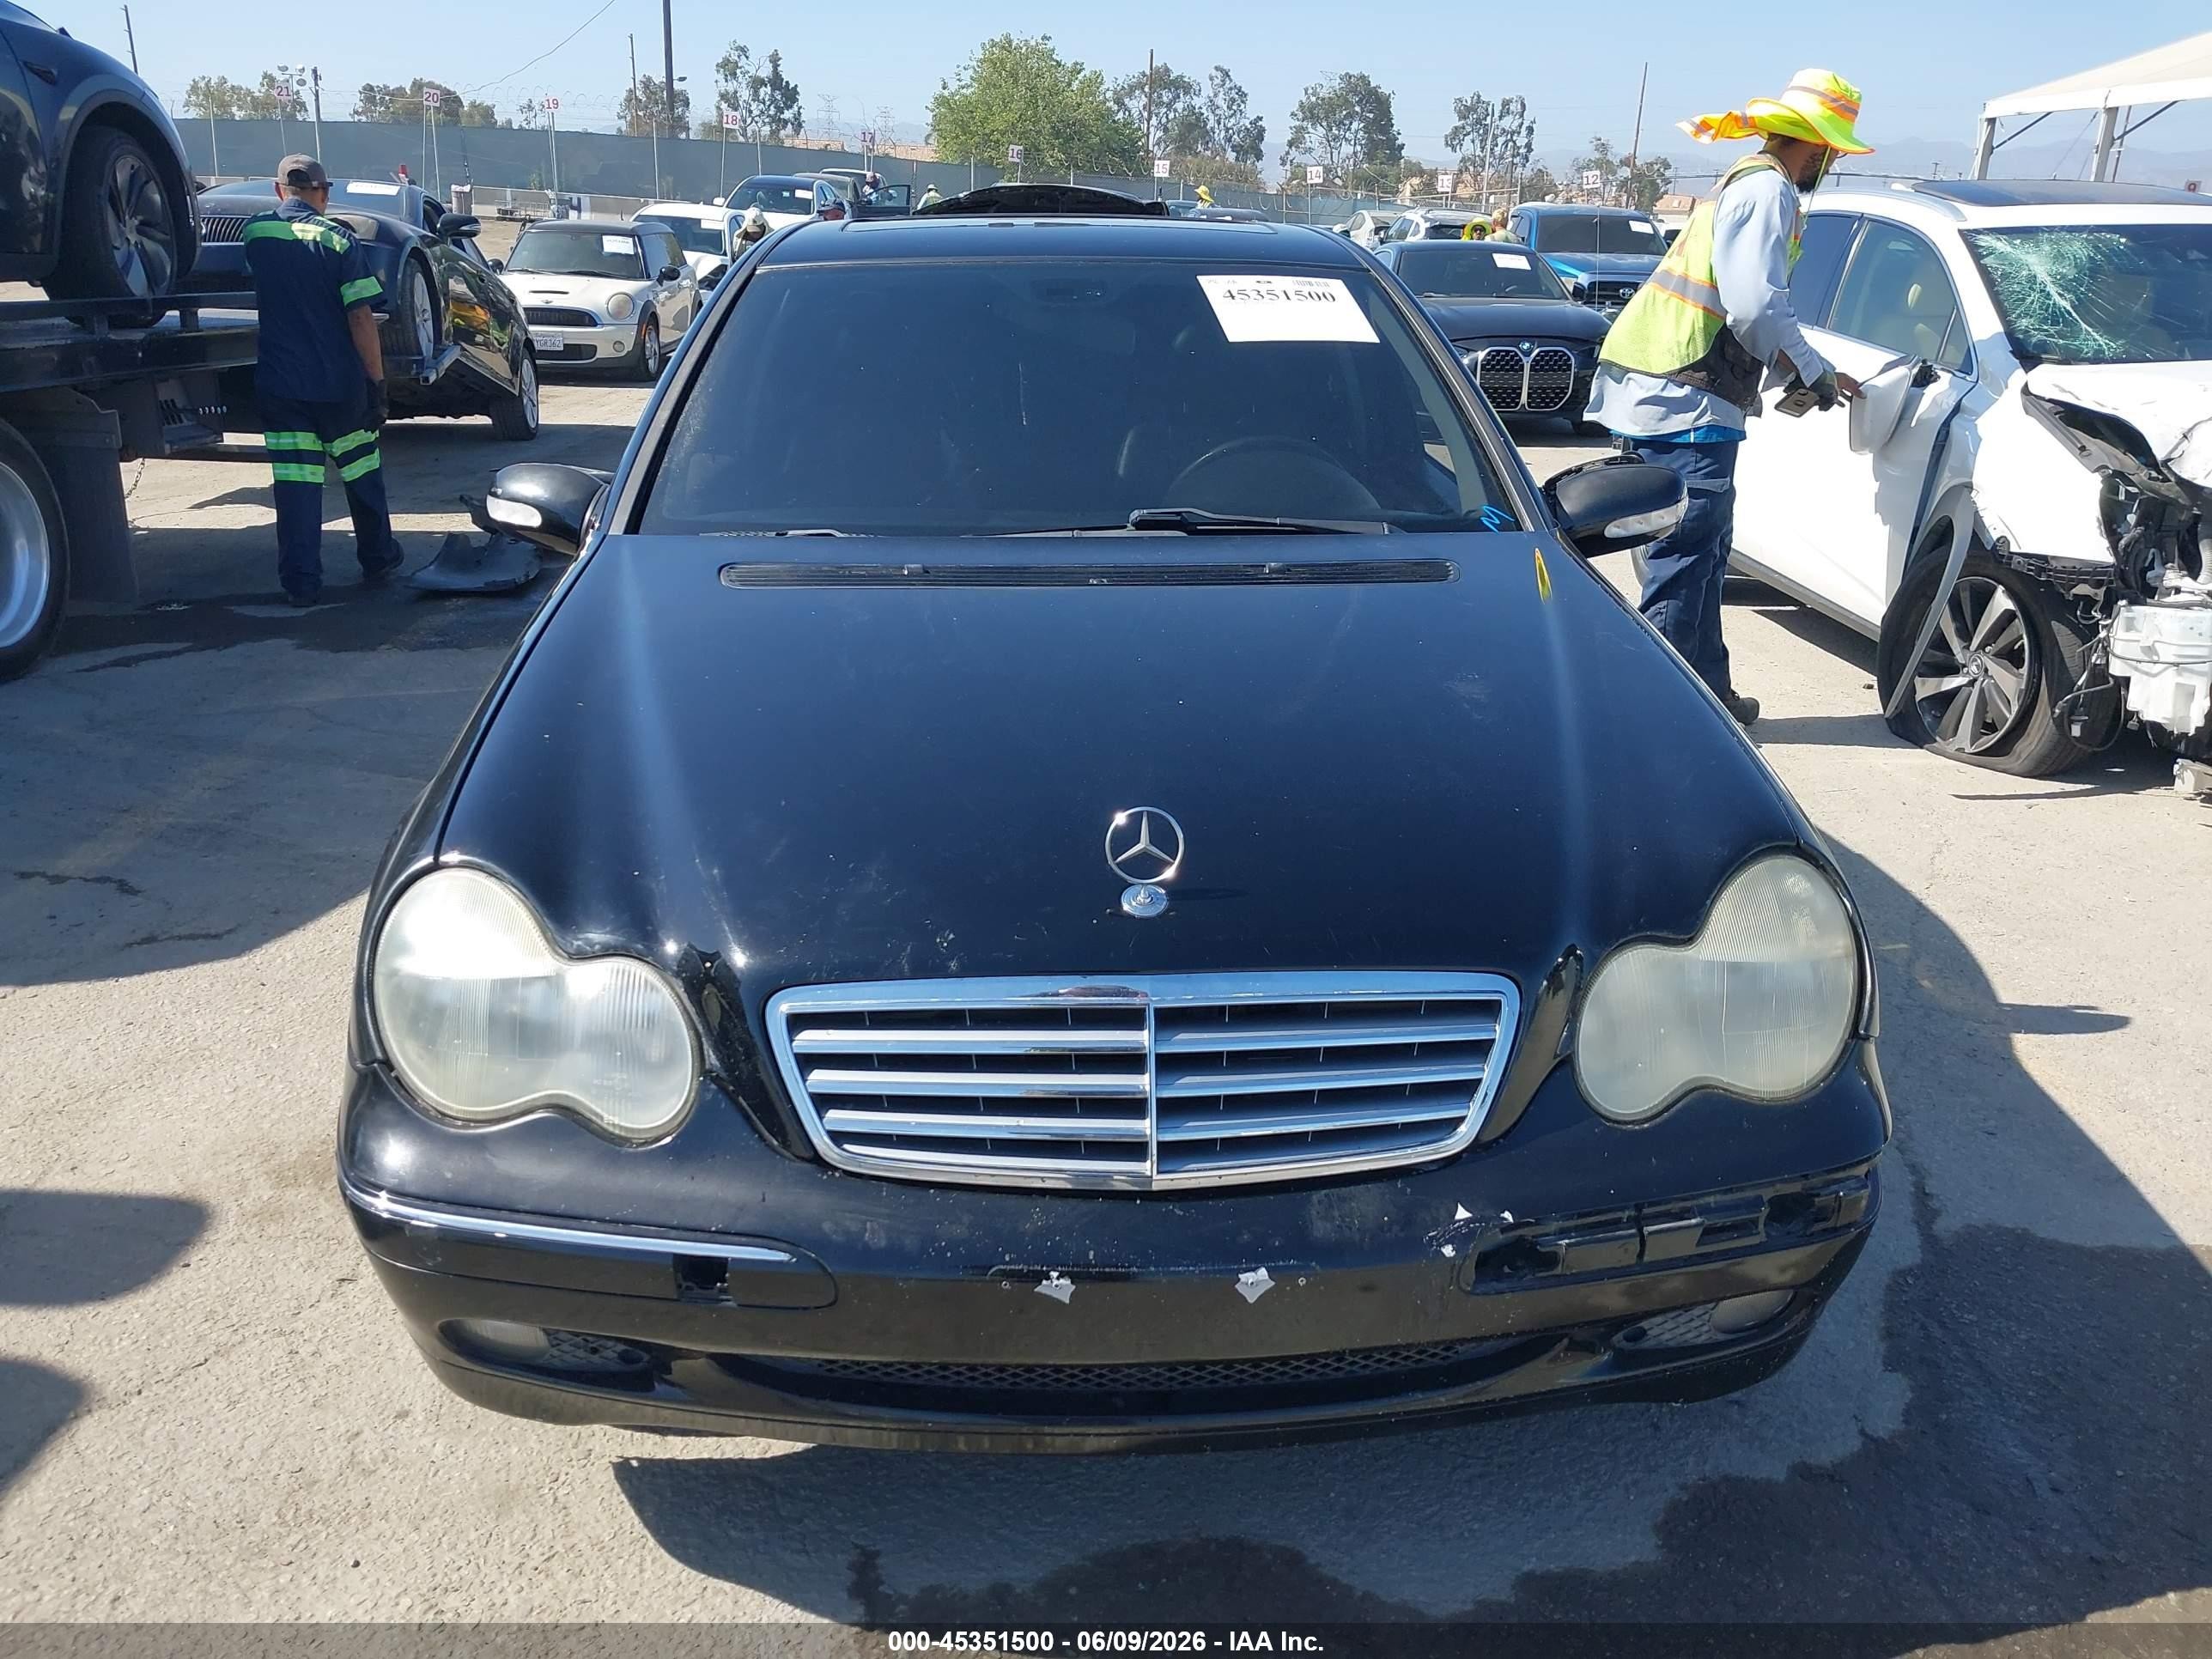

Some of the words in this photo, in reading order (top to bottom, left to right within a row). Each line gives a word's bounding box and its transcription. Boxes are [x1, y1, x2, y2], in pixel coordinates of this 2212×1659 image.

[276, 85, 291, 97] 21
[424, 91, 439, 104] 20
[545, 98, 559, 110] 19
[724, 114, 738, 126] 18
[861, 131, 873, 143] 17
[1010, 148, 1022, 159] 16
[1155, 164, 1168, 174] 15
[1308, 169, 1322, 180] 14
[1584, 174, 1599, 186] 12
[1222, 289, 1337, 303] 45351500
